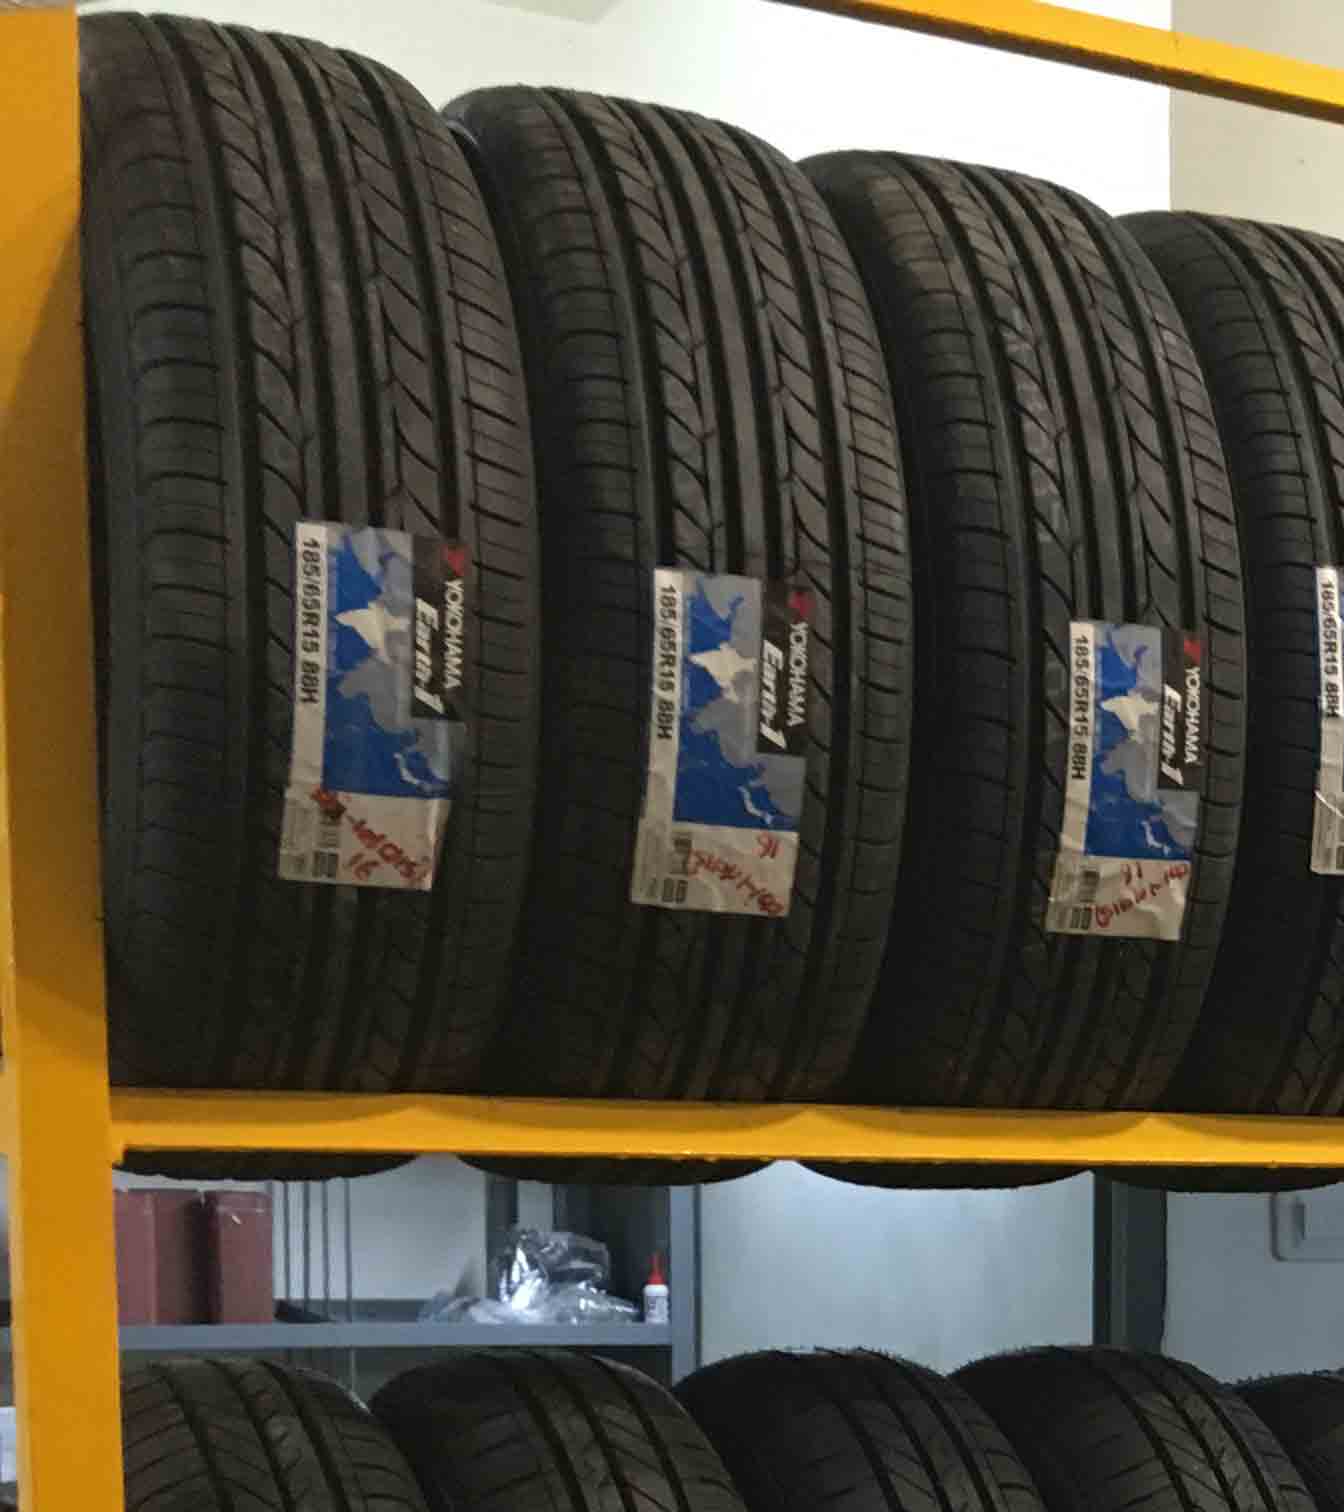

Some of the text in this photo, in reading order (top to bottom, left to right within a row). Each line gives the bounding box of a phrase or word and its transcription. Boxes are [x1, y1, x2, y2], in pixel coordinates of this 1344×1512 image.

[443, 577, 465, 689] YOKOHAMA
[787, 620, 810, 726] YOKOHAMA
[1184, 664, 1201, 764] YOKOHAMA
